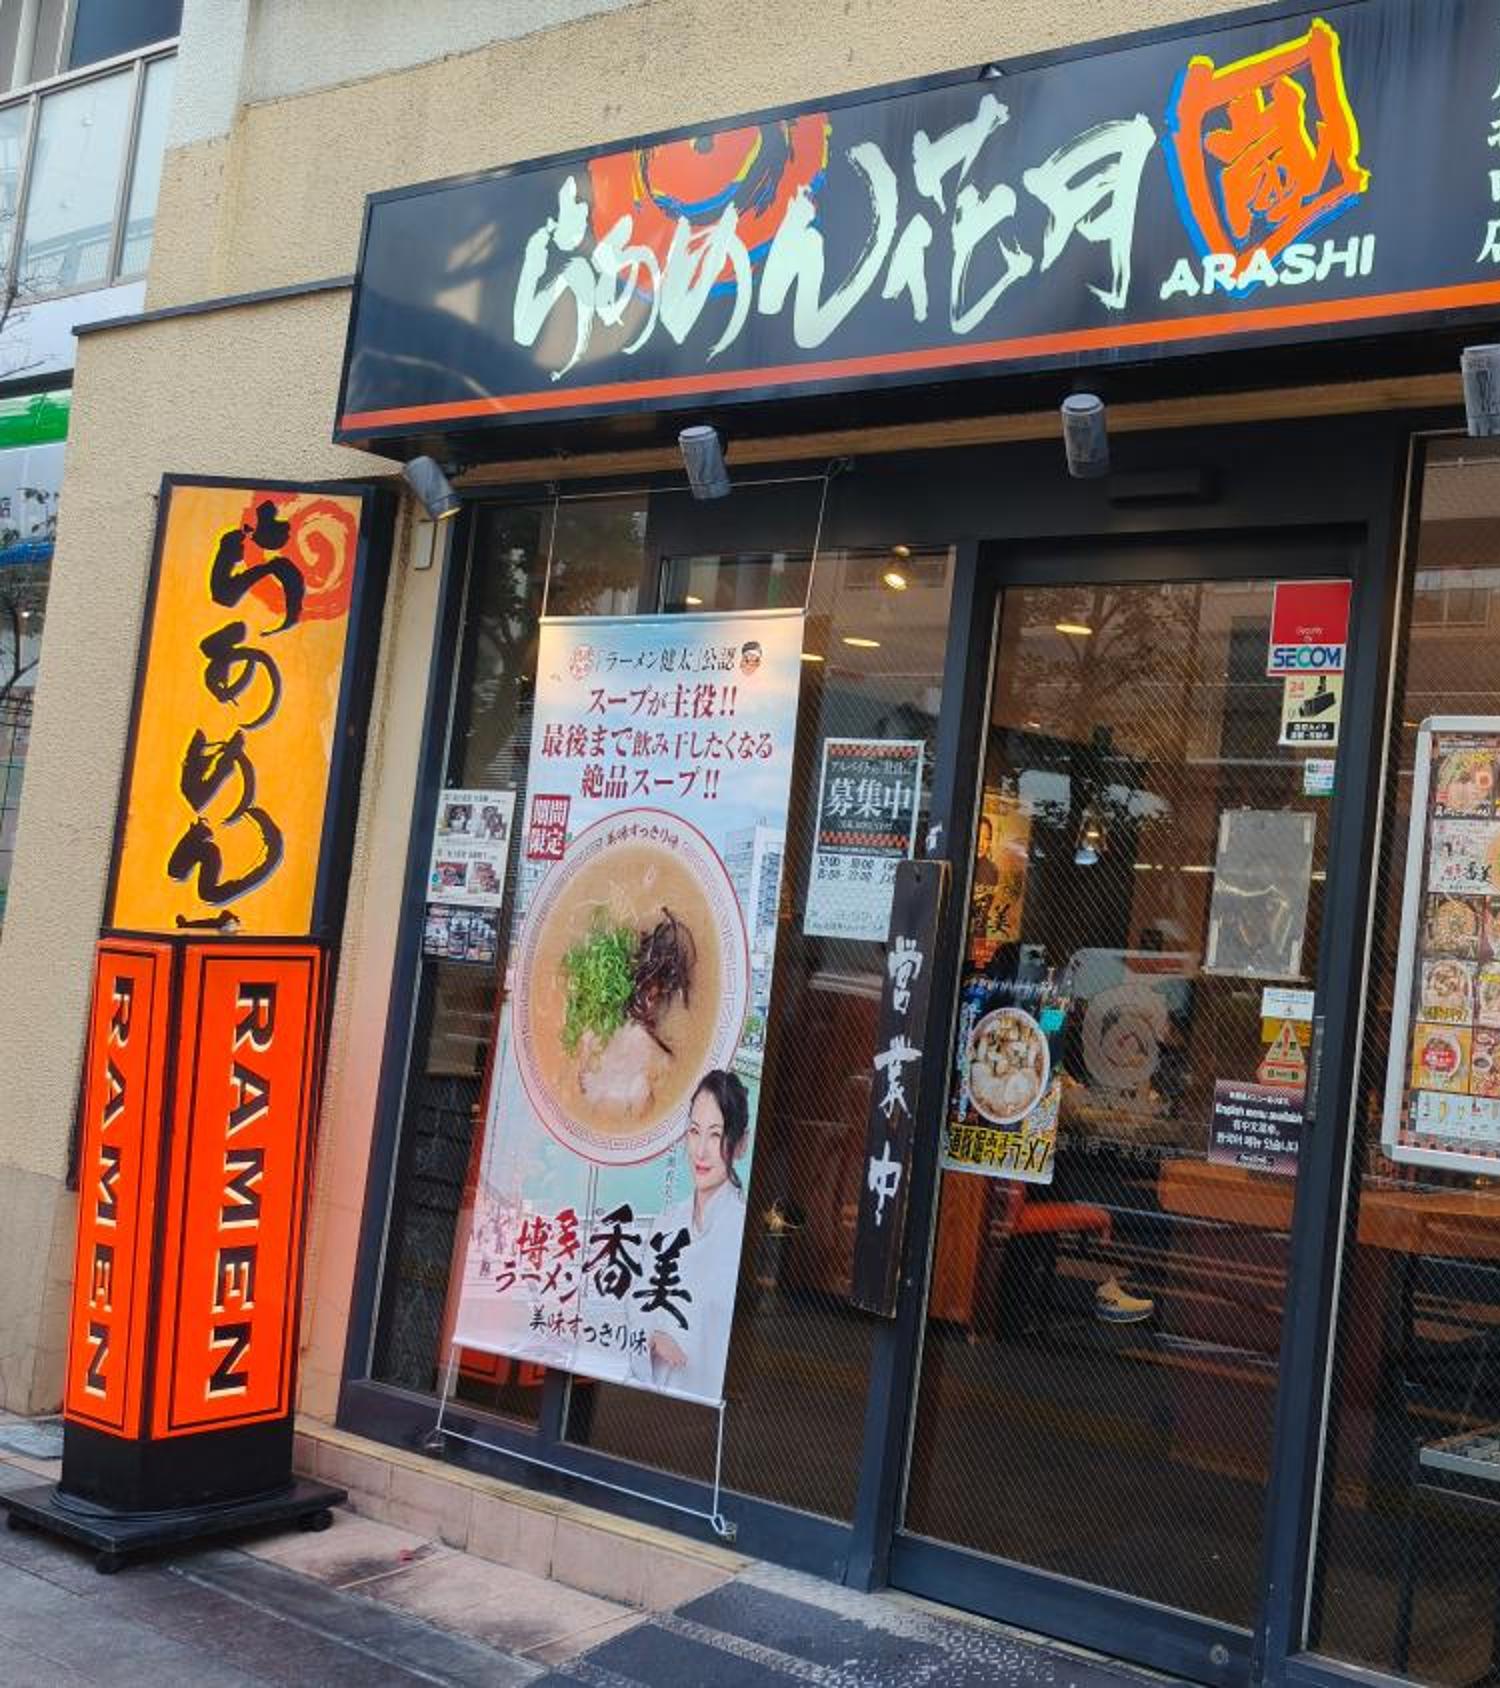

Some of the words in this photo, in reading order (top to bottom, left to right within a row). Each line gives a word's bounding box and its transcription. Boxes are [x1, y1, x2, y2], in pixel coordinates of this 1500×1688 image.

[1159, 234, 1376, 300] ARASHI
[1274, 645, 1342, 668] SECOM
[541, 723, 774, 761] 最後まで飲み干したくなる
[824, 777, 912, 820] 募集中
[867, 934, 930, 1226] 営業中
[84, 975, 136, 1400] RAMEN
[207, 980, 279, 1401] RAMEN
[517, 1208, 581, 1271] 博多
[581, 1203, 693, 1331] 香美
[496, 1260, 578, 1304] ラーメン
[530, 1304, 650, 1356] 美味すっきり味
